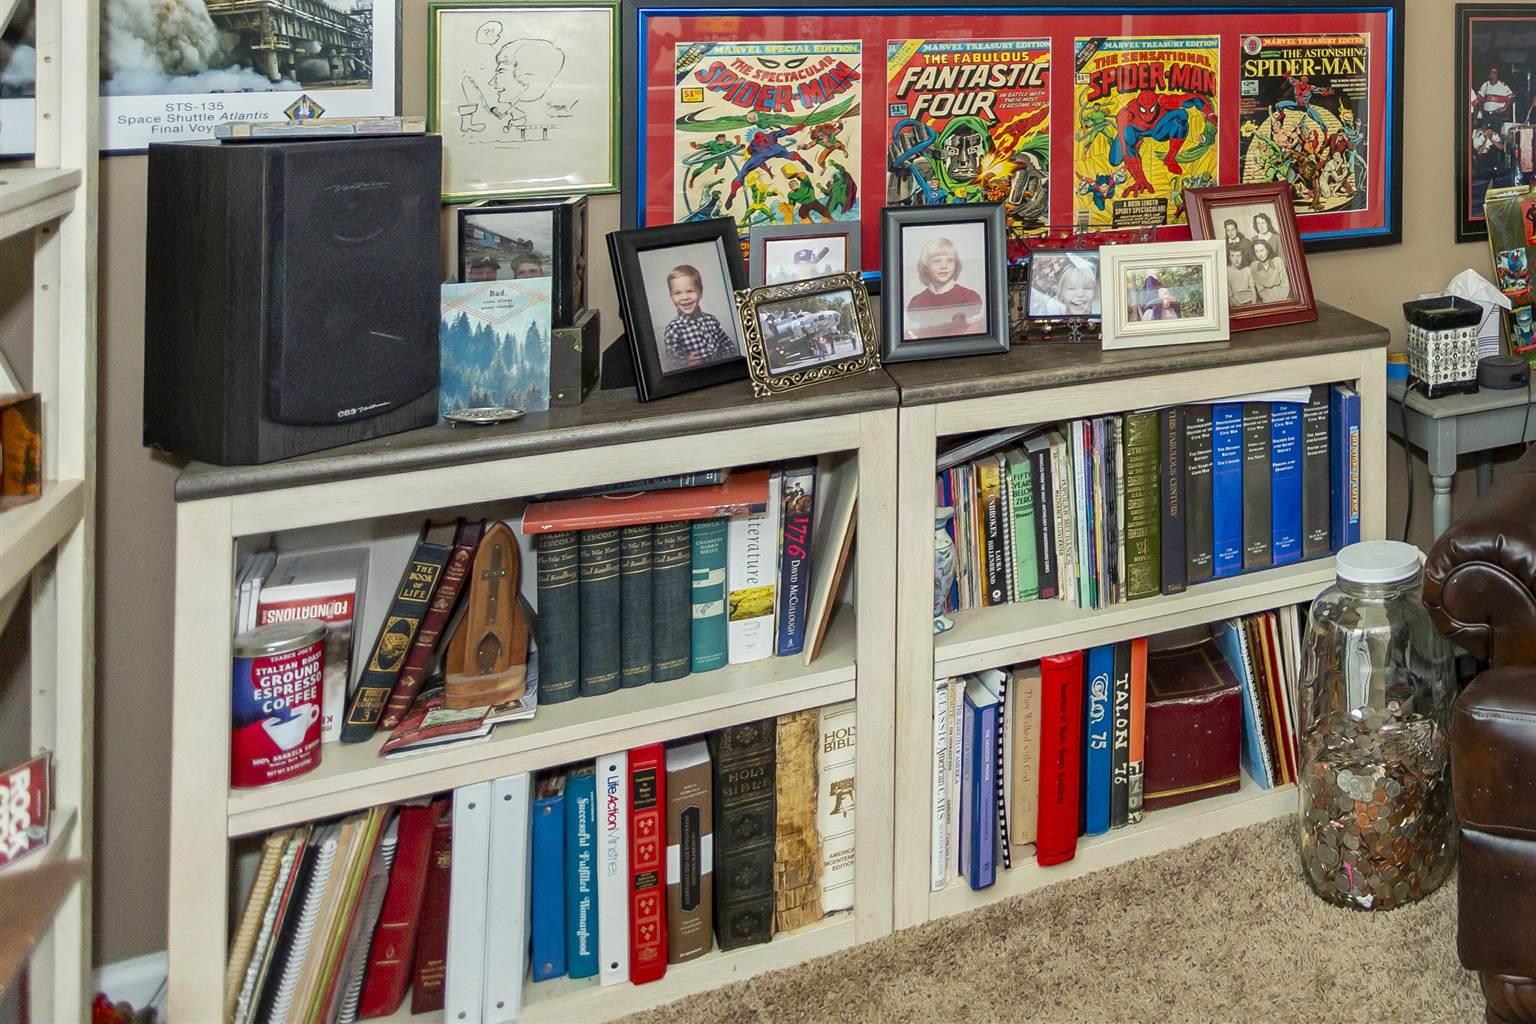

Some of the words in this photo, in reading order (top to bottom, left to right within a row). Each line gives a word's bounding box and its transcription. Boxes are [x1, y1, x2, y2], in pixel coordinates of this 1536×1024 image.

[714, 45, 762, 54] MARVEL
[765, 45, 812, 54] SPECIAL
[814, 43, 860, 53] EDITION
[923, 42, 964, 51] MARVEL
[966, 41, 1014, 50] TREASURY
[1016, 40, 1050, 49] EDITION
[1104, 41, 1141, 49] MARVEL
[1142, 40, 1185, 48] TREASURY
[1186, 39, 1218, 47] EDITION
[1282, 48, 1302, 58] THE
[1305, 47, 1367, 58] ASTONISHING
[730, 56, 754, 75] THE
[755, 55, 837, 83] SPECTACULAR
[924, 54, 949, 64] THE
[954, 52, 1029, 63] FABULOUS
[1094, 54, 1118, 68] THE
[1121, 51, 1212, 67] SENSATIONAL
[1245, 57, 1366, 77] SPIDER-MAN
[694, 60, 861, 113] SPIDER-MAN
[896, 63, 1049, 98] FANTASTIC
[1087, 62, 1216, 102] SPIDER-MAN
[117, 114, 162, 126] Space
[167, 112, 216, 124] Shuttle
[219, 109, 270, 121] Atlantis
[165, 101, 225, 112] STS-135
[909, 91, 998, 121] FOUR
[151, 124, 185, 134] Final
[1169, 432, 1177, 475] FABULOUS
[1013, 472, 1032, 482] FIFTY
[1015, 495, 1033, 505] ZERO
[1170, 478, 1178, 518] CENTURY
[985, 494, 998, 538] UNBROKEN
[747, 515, 764, 584] iterature
[784, 516, 809, 560] 1776
[409, 572, 433, 583] BOOK
[416, 564, 435, 574] THE
[790, 559, 801, 583] DAVID
[402, 588, 428, 600] LIFE
[255, 661, 298, 676] ITALIAN
[302, 650, 321, 665] ROAST
[260, 661, 320, 688] GROUND
[254, 671, 321, 701] ESPRESSO
[262, 686, 317, 713] COFFEE
[1115, 673, 1128, 750] TALON
[824, 736, 855, 754] BIBL
[1091, 731, 1107, 750] 75
[936, 747, 947, 787] American
[1023, 760, 1031, 783] God
[1115, 762, 1127, 784] 76
[936, 788, 946, 820] CARS
[577, 796, 590, 848] Successful
[578, 851, 590, 893] Fulfilled
